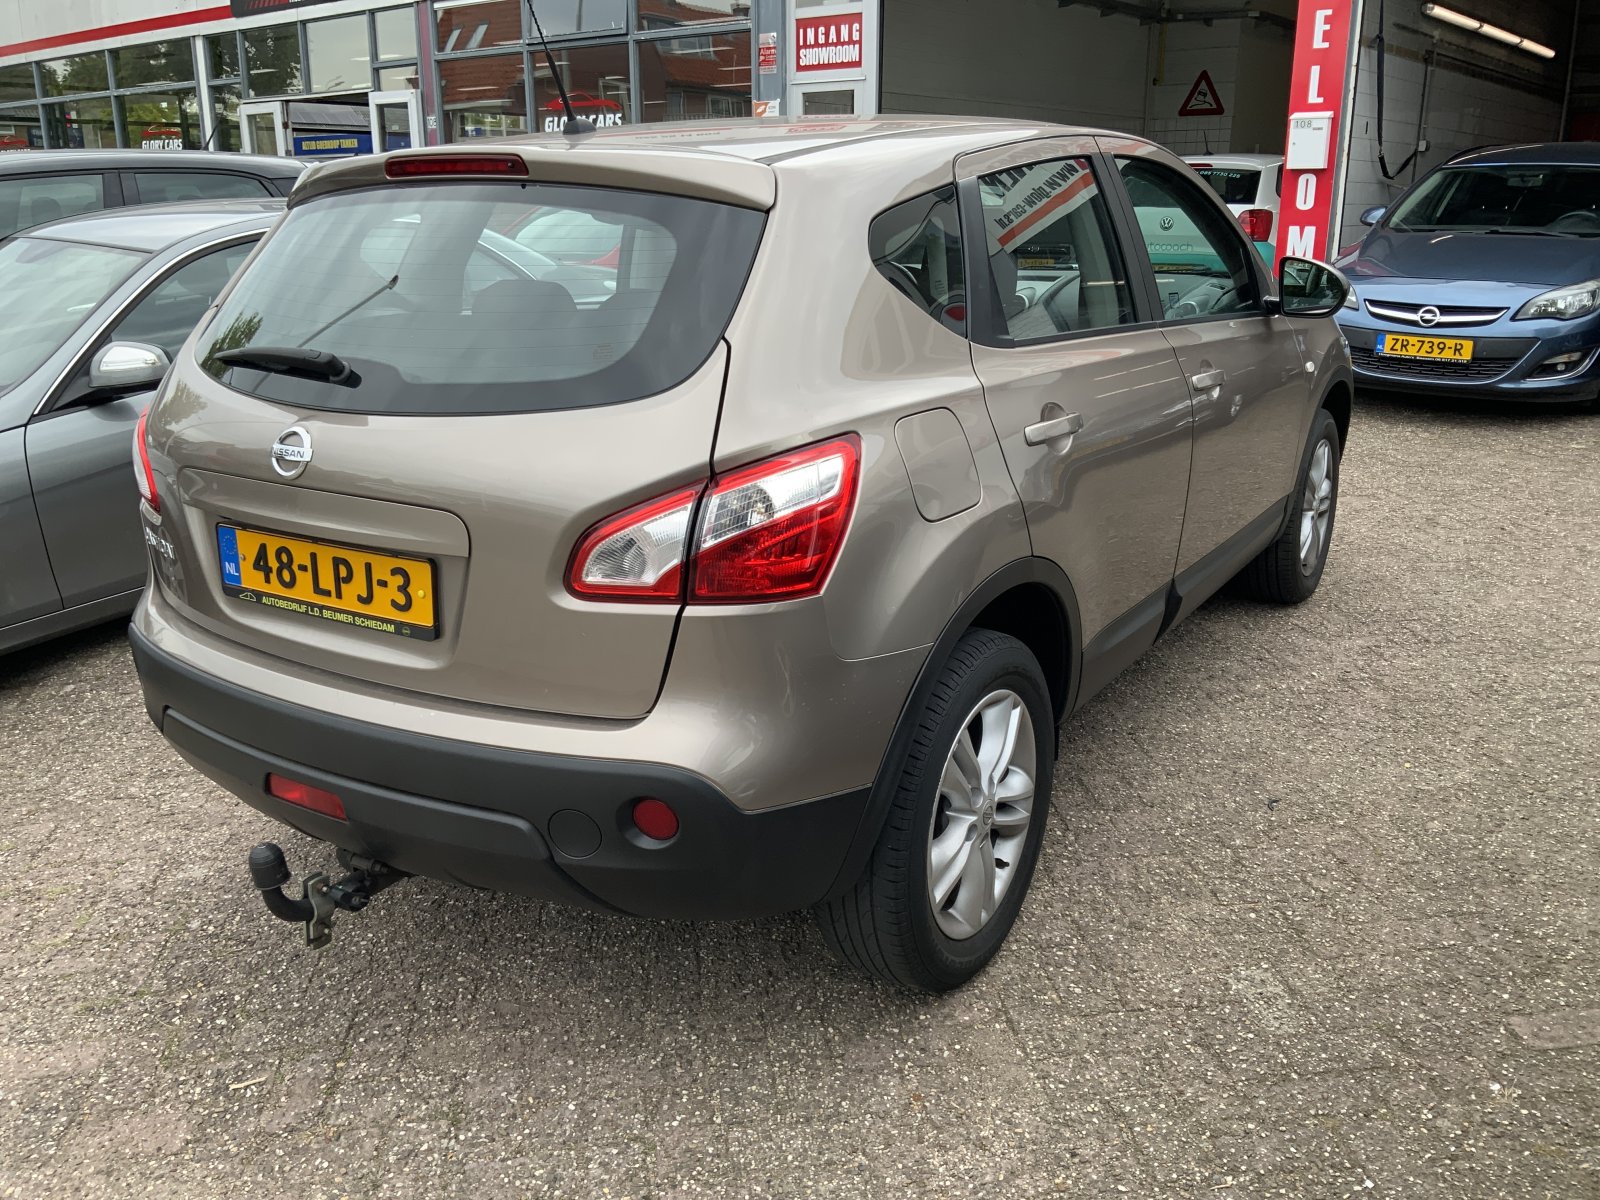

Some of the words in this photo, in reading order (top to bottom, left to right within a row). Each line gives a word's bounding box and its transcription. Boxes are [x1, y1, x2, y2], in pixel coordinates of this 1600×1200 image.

[799, 23, 860, 46] INGANG
[799, 44, 860, 66] SHOWROOM
[544, 116, 588, 133] GLO
[589, 113, 623, 128] CARS
[1295, 120, 1312, 129] 108
[1287, 9, 1333, 259] ELOM
[142, 140, 164, 150] GLORY
[165, 139, 183, 150] CARS
[1390, 338, 1464, 357] ZR-739-R
[273, 447, 305, 458] NISSAN
[225, 561, 240, 576] NL
[252, 542, 413, 613] 48-LPJ-3
[262, 596, 308, 613] AUTOBEDRIJF
[308, 606, 322, 618] L.D.
[322, 609, 354, 625] BEUMER
[355, 616, 395, 633] SCHIEDAM
